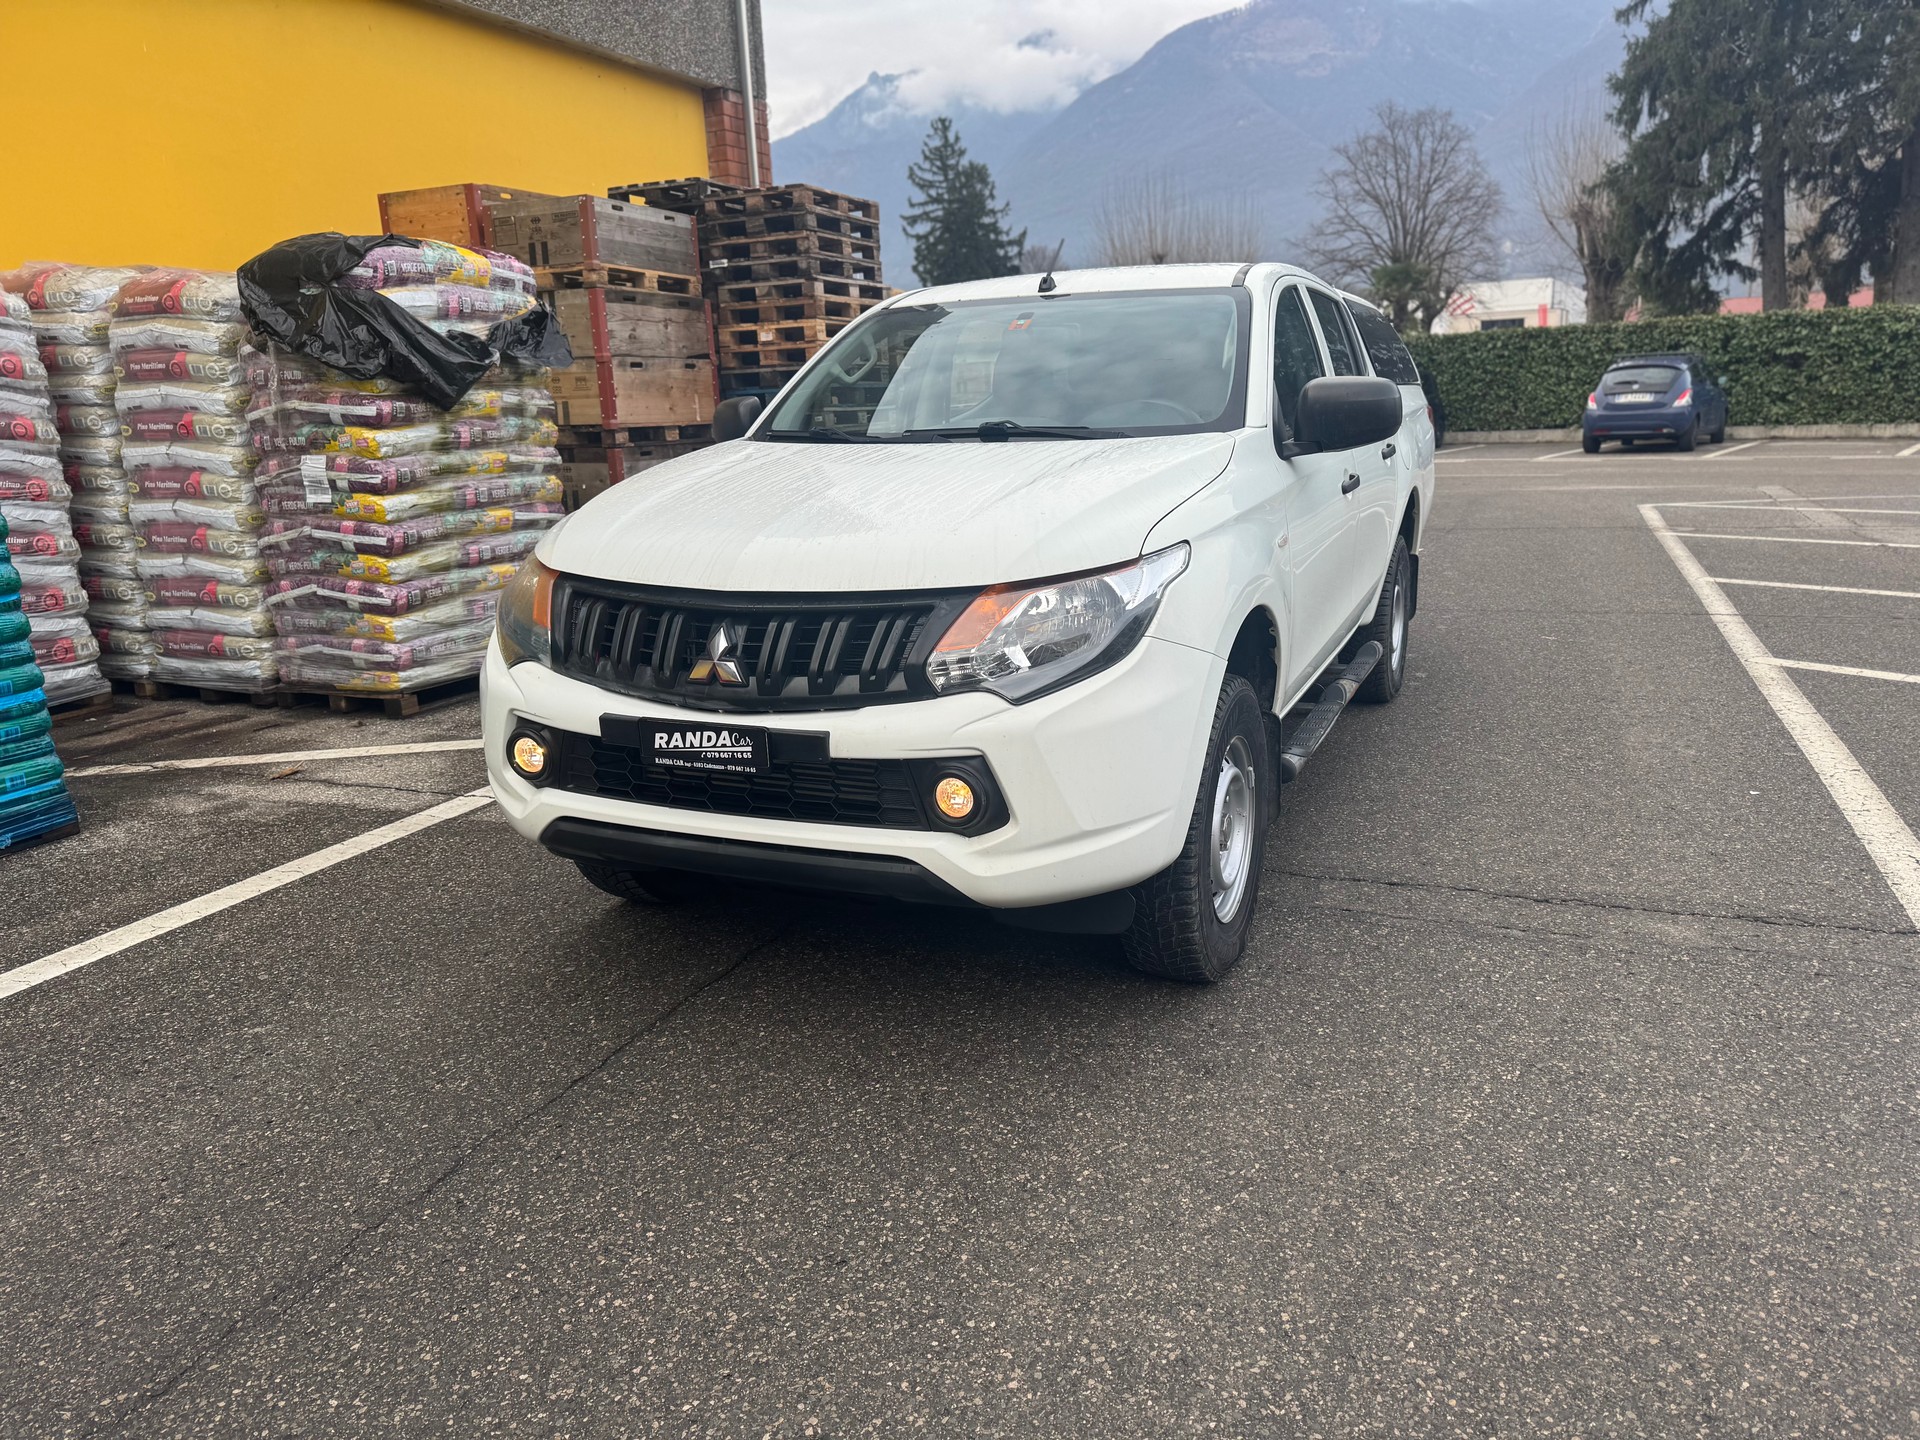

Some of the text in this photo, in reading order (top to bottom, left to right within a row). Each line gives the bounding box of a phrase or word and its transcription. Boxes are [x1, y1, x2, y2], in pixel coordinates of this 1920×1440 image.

[142, 362, 166, 370] Marittimo
[137, 422, 173, 430] Pino Marittimo
[654, 730, 753, 749] RANDA Car
[655, 757, 673, 765] RANDA
